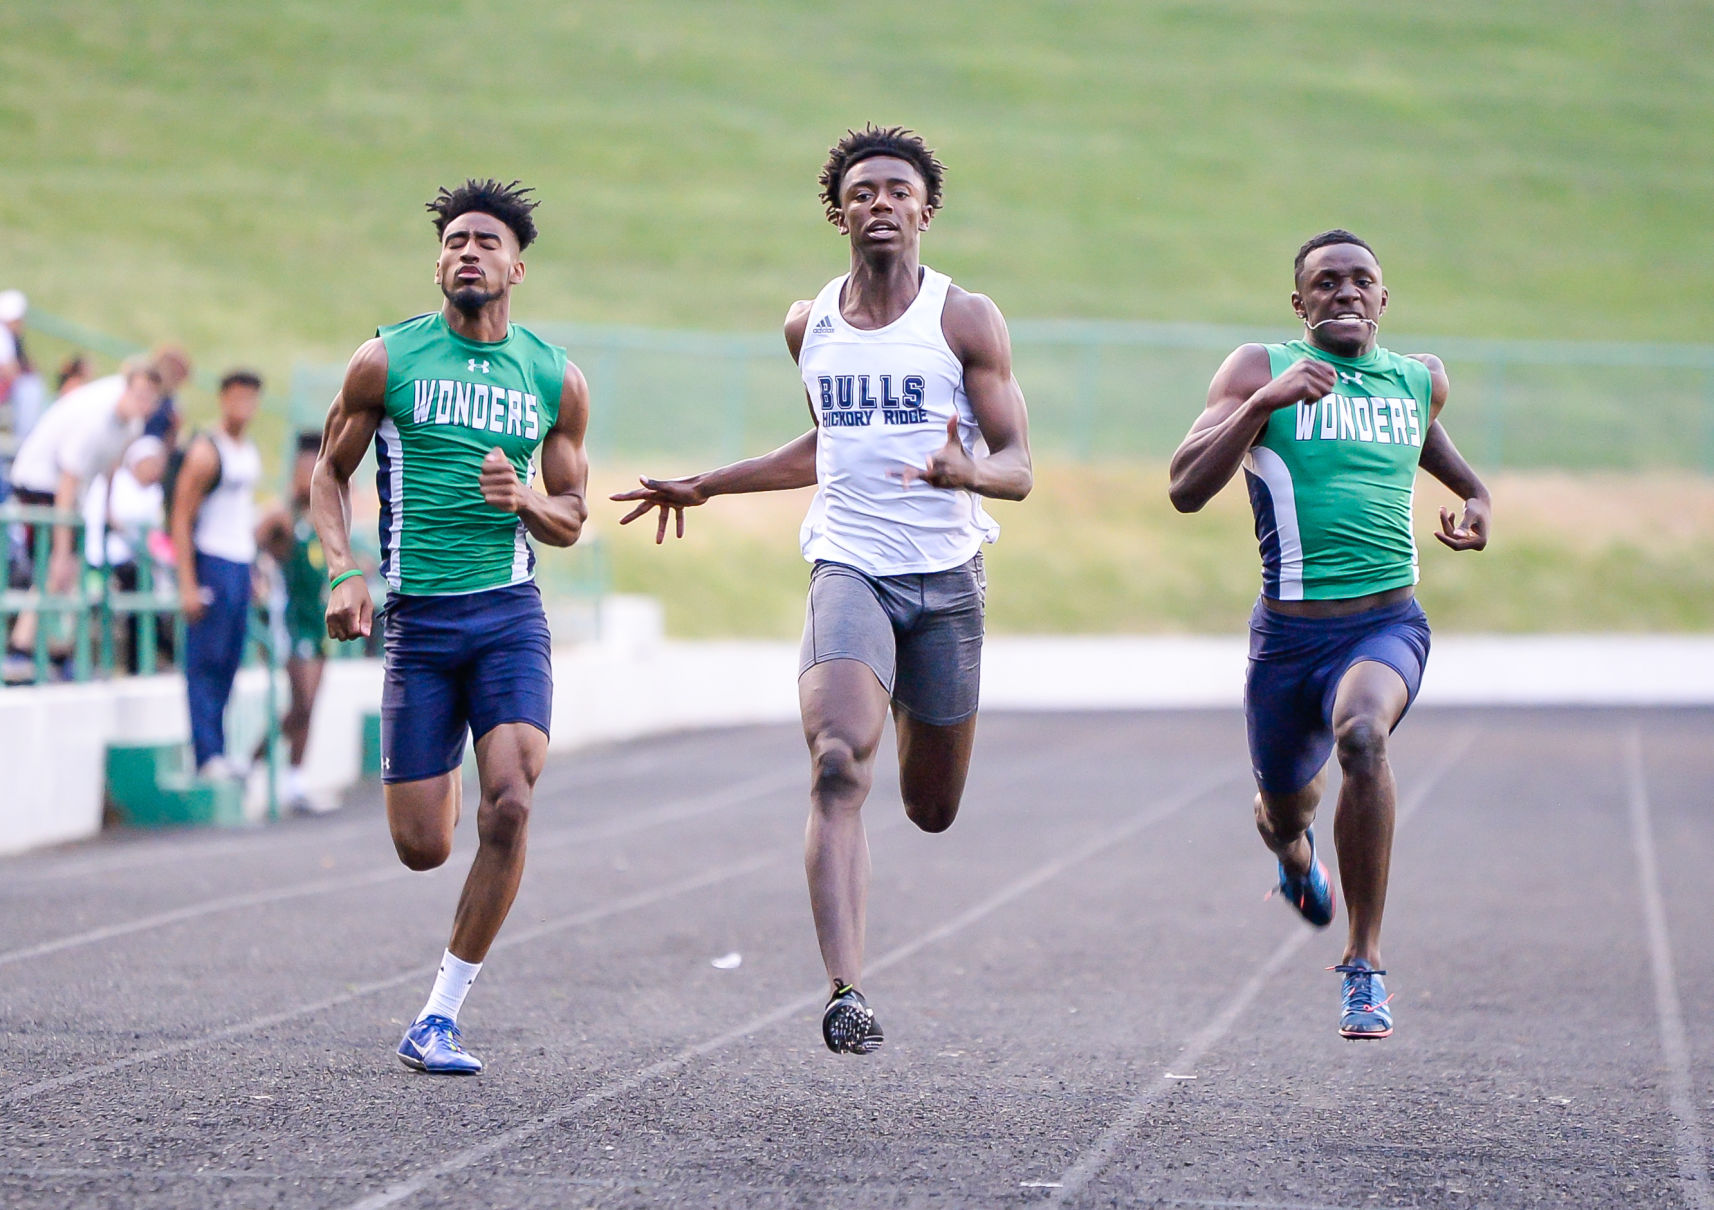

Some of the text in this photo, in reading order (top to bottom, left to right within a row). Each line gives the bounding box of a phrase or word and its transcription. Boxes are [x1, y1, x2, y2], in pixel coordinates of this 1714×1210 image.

[413, 379, 539, 440] WONDERS
[818, 375, 925, 410] BULLS
[822, 409, 929, 427] HICKORY RIDGE
[1295, 392, 1421, 447] WONDERS
